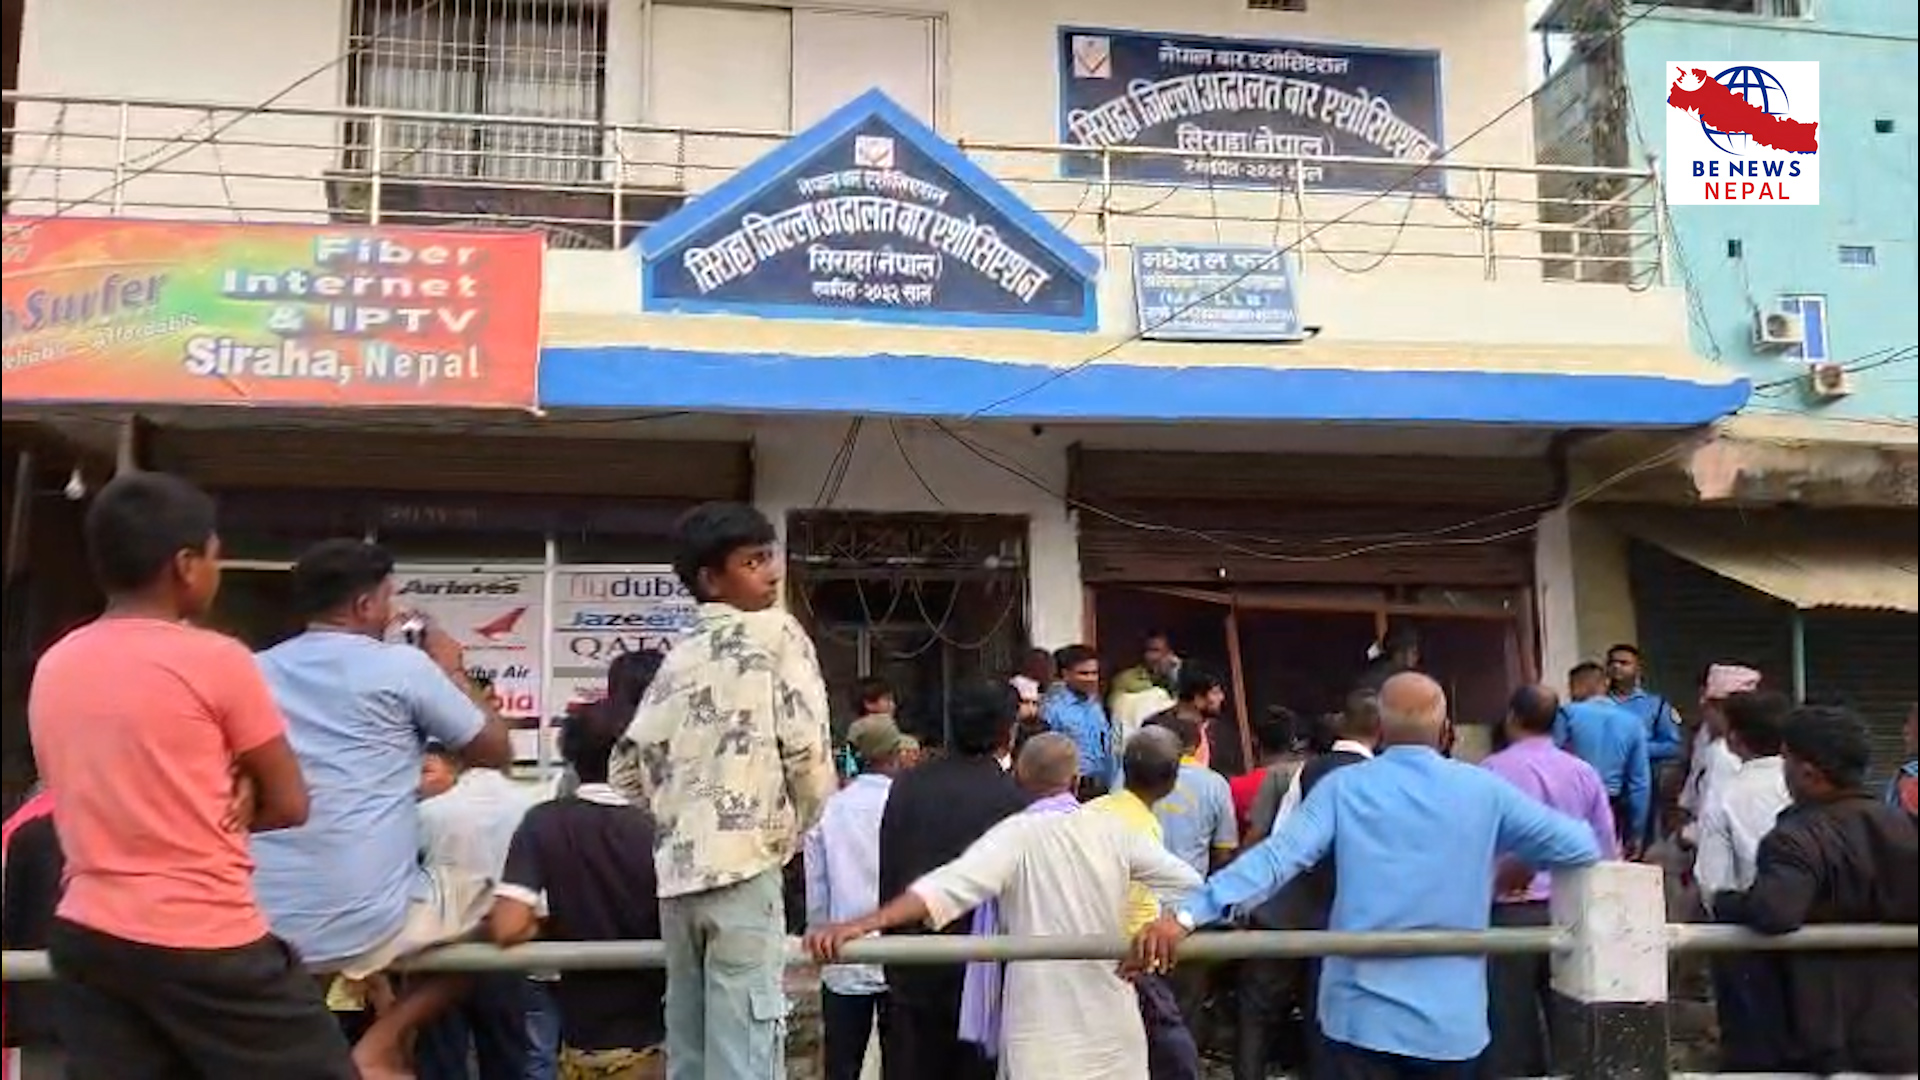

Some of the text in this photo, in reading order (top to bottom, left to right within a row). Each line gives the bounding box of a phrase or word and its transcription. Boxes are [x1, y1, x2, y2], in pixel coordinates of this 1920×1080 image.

[1199, 71, 1283, 112] अदालत
[816, 195, 897, 237] अदालत
[316, 235, 477, 264] Fiber
[807, 244, 872, 280] सिराहा
[223, 269, 478, 298] Internet
[23, 272, 168, 332] Surfer
[269, 304, 478, 333] & IPTV
[185, 335, 480, 385] Siraha, Nepal
[570, 637, 674, 660] QATA
[502, 665, 530, 679] Air
